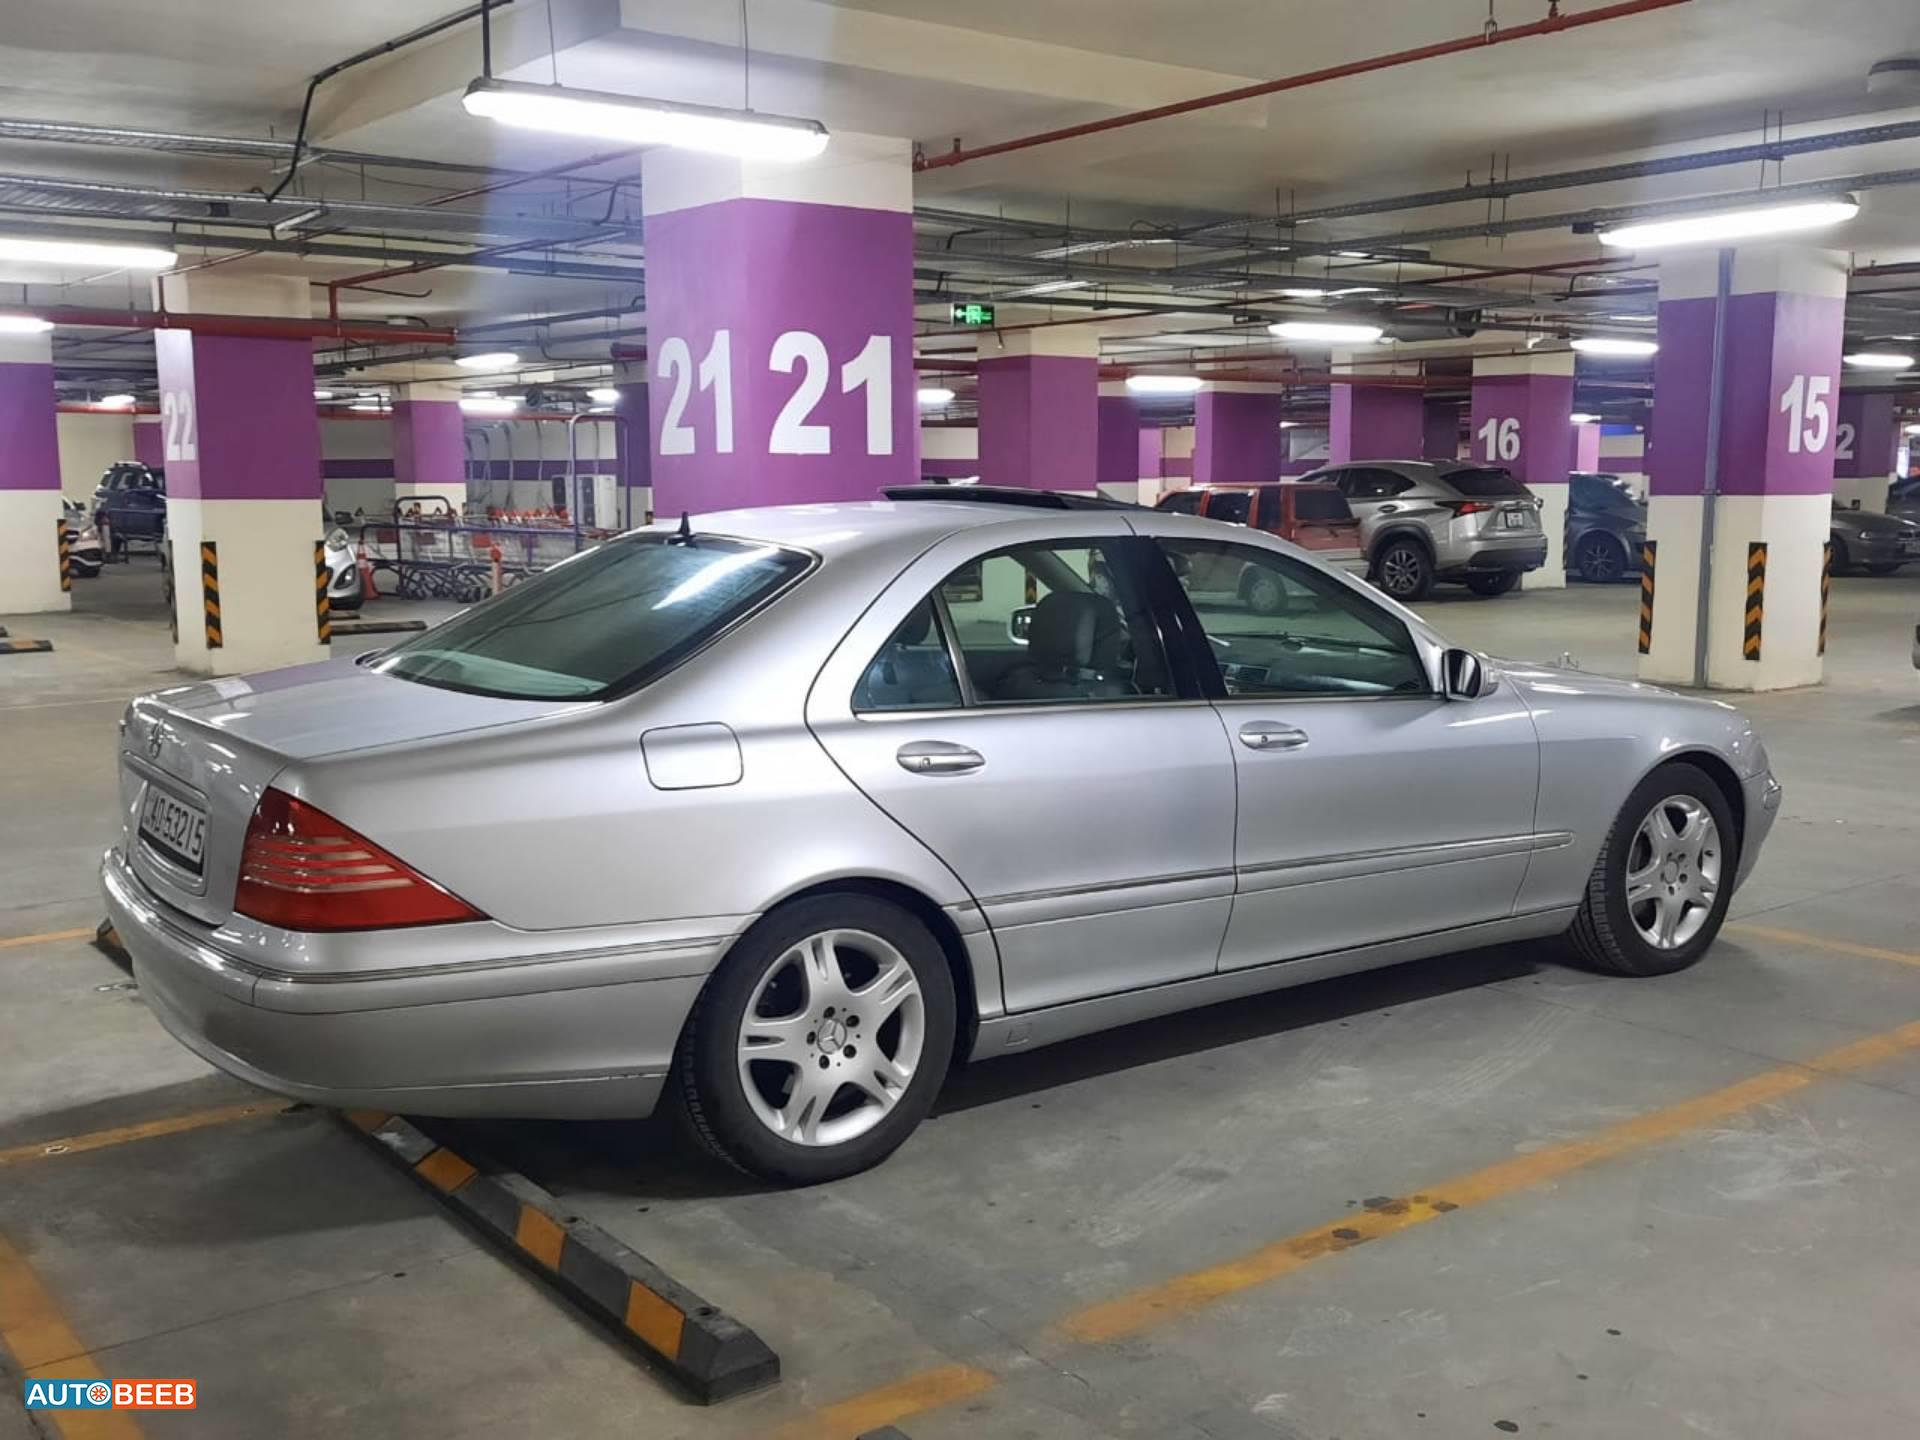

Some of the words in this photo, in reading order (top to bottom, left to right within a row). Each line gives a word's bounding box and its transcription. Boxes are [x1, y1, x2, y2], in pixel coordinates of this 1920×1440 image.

[164, 391, 196, 461] 22
[657, 330, 733, 455] 21
[769, 331, 893, 455] 21
[1780, 375, 1831, 453] 15
[1478, 417, 1520, 461] 16
